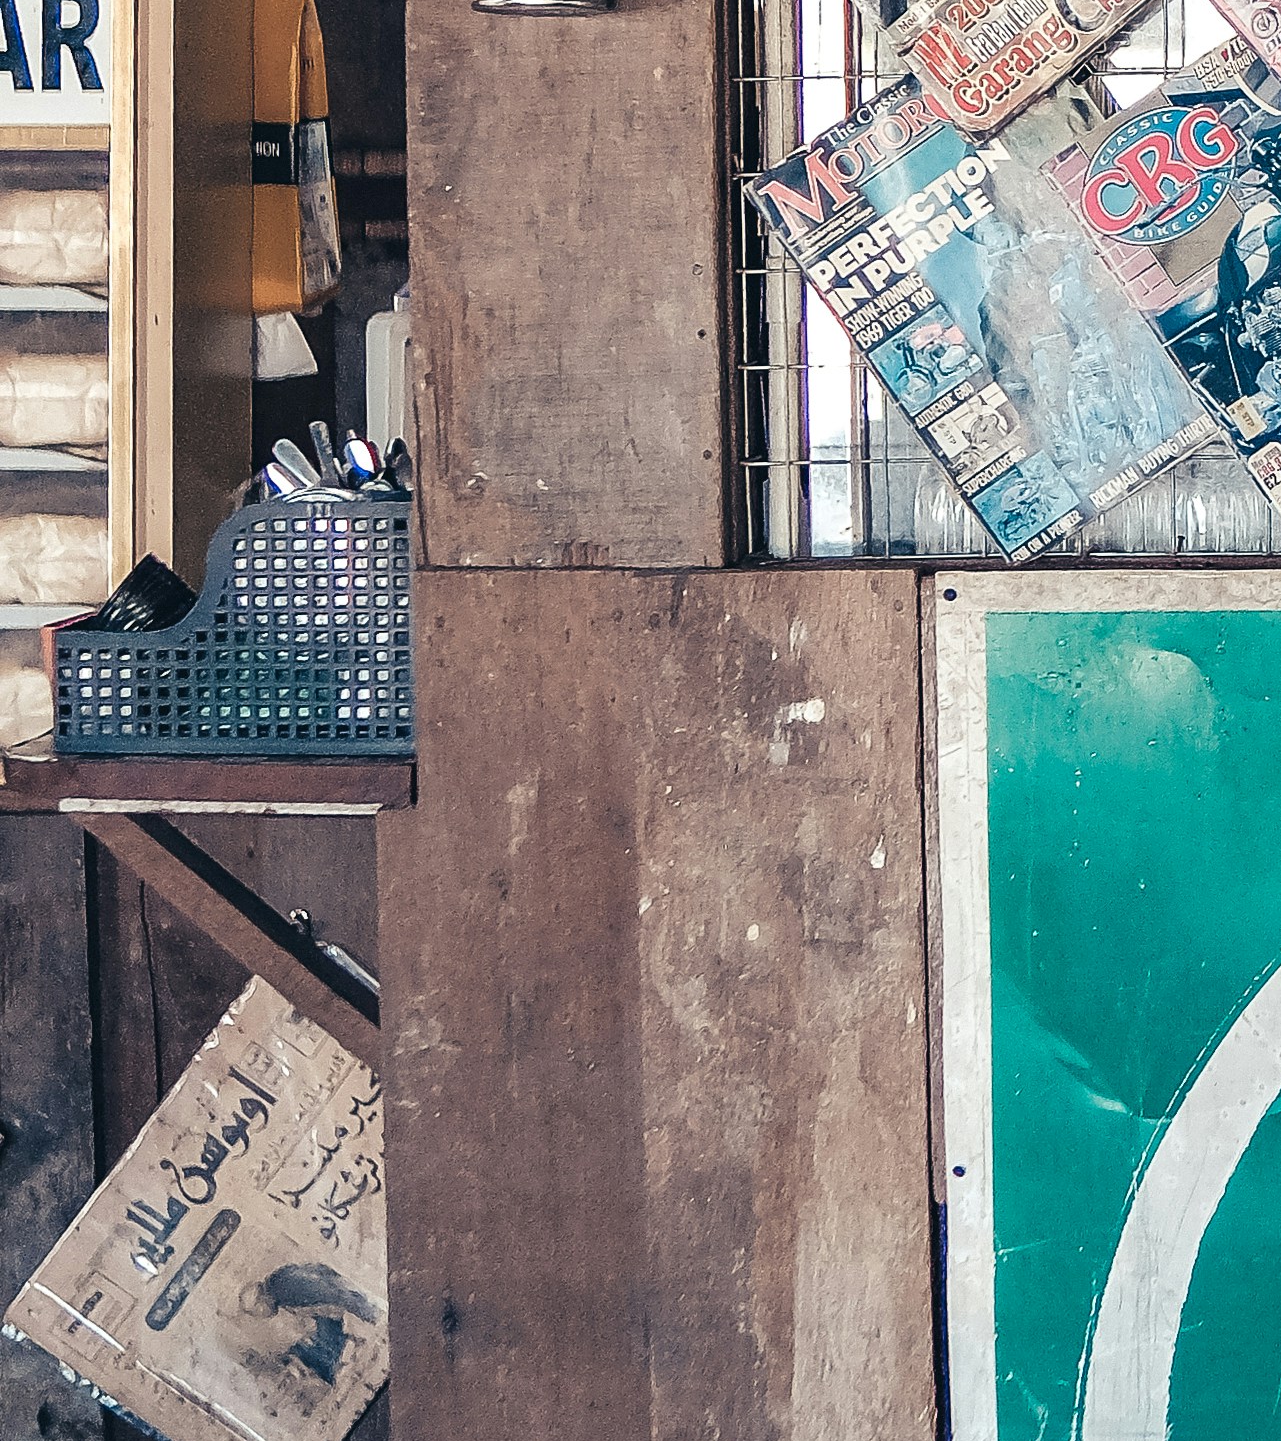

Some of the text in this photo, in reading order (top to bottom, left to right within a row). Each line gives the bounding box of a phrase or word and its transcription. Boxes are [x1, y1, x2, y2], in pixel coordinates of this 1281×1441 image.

[823, 83, 909, 147] The Classic
[946, 8, 1075, 119] Garang
[806, 138, 1010, 293] PERFECTION
[1082, 105, 1239, 236] CRG
[825, 189, 996, 316] IN PURPLE
[1132, 216, 1182, 241] BIKE
[855, 288, 936, 348] 1969 TIGER 100
